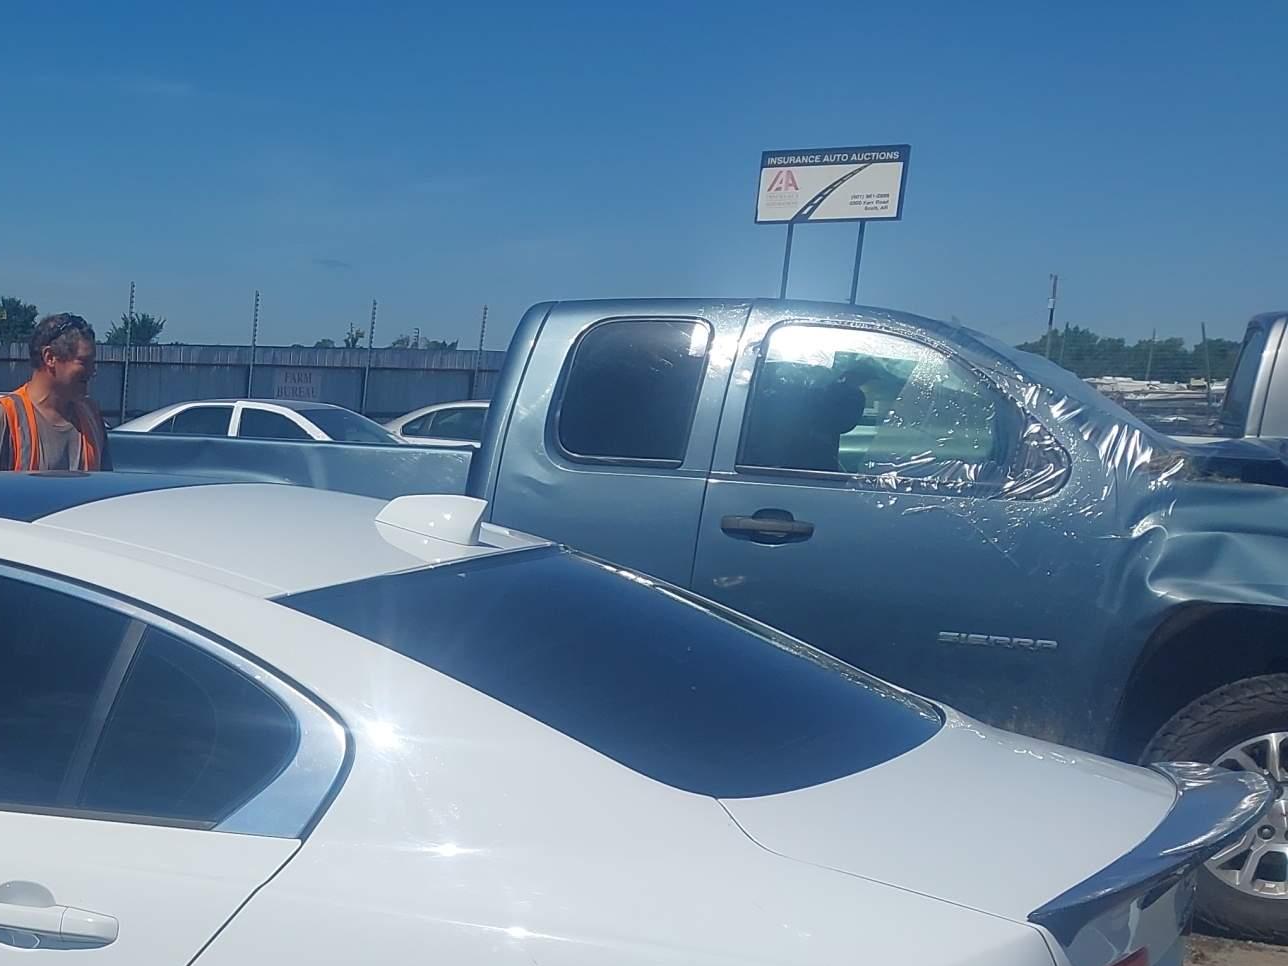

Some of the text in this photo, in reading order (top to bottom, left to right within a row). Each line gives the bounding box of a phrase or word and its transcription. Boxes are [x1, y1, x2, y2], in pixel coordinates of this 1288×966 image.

[767, 151, 900, 165] INSURANCE AUTO AUCTIONS
[284, 371, 312, 384] FARM
